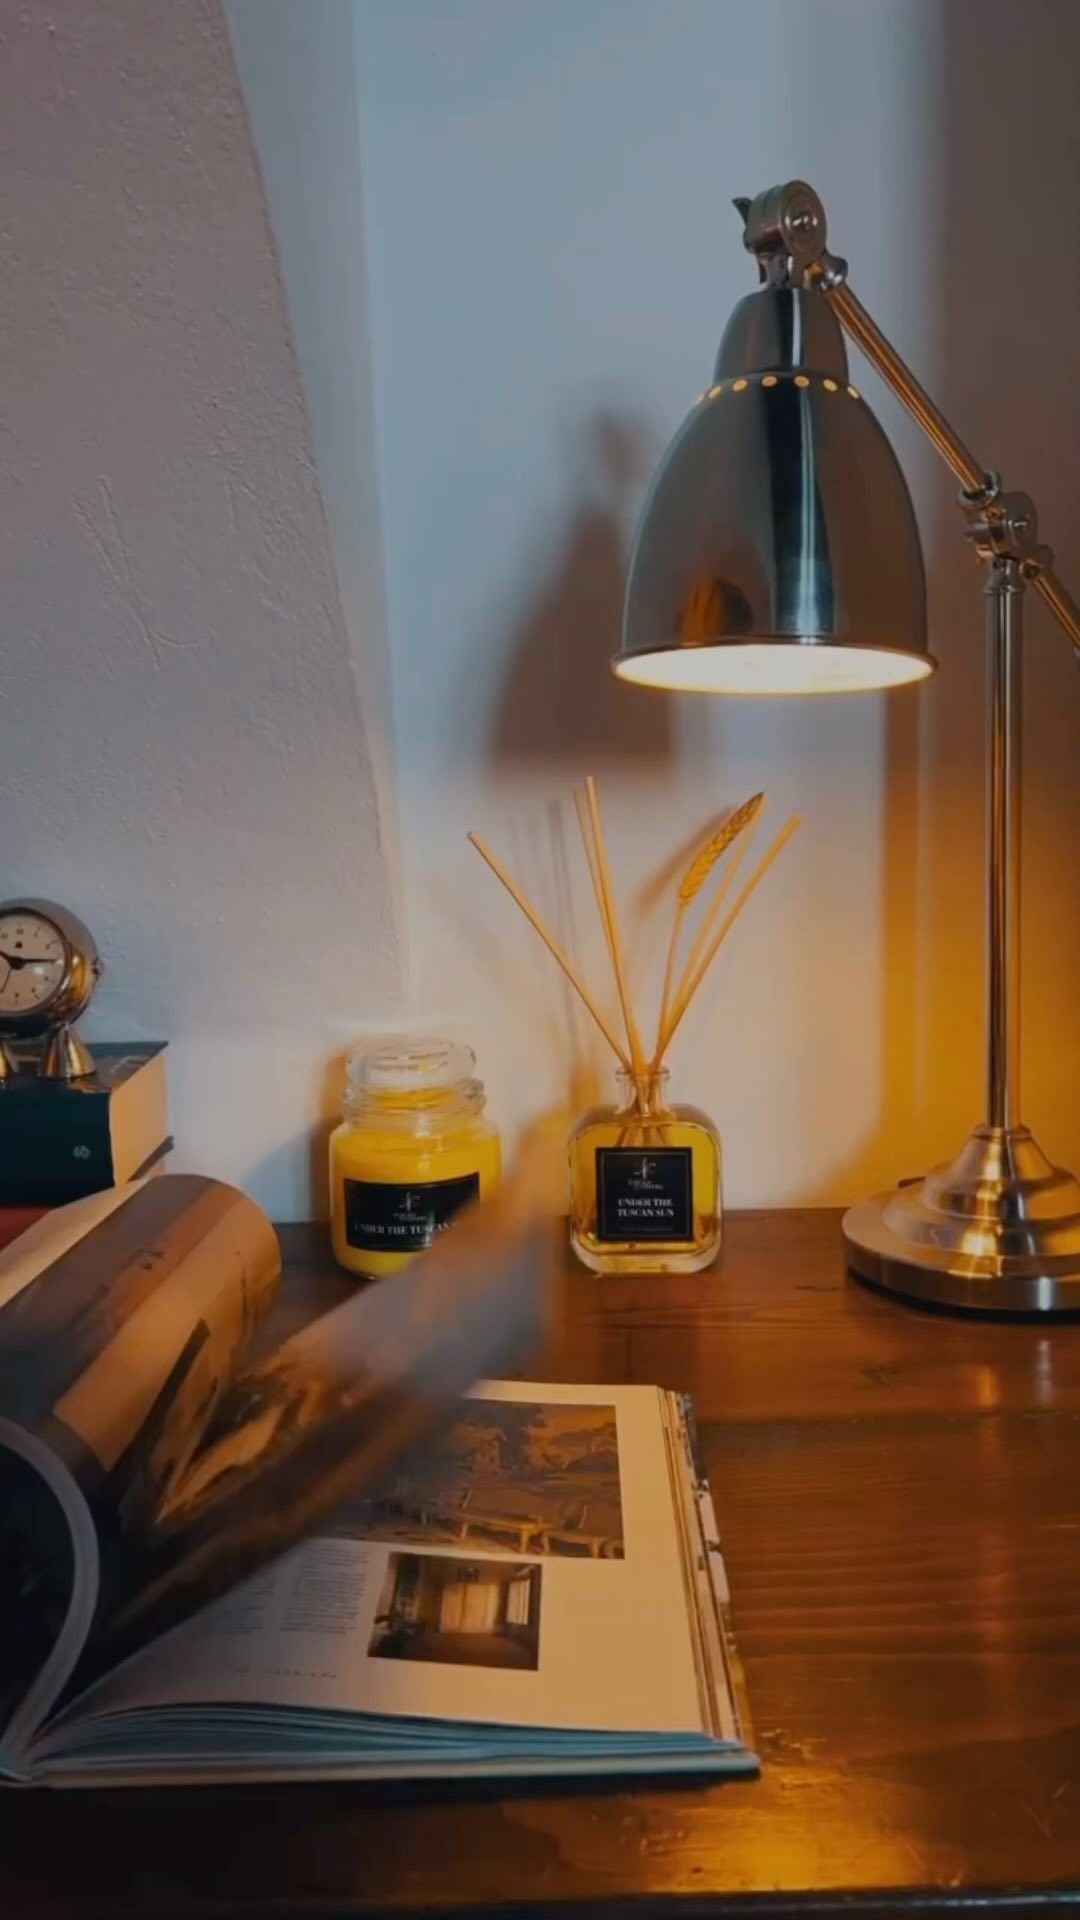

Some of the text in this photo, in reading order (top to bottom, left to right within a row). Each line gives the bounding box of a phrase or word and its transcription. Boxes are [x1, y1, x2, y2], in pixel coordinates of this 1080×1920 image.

[618, 1198, 673, 1207] UNDER THE
[617, 1208, 675, 1217] TUSCAN SUN
[354, 1222, 385, 1234] UNDER
[387, 1225, 408, 1235] THE
